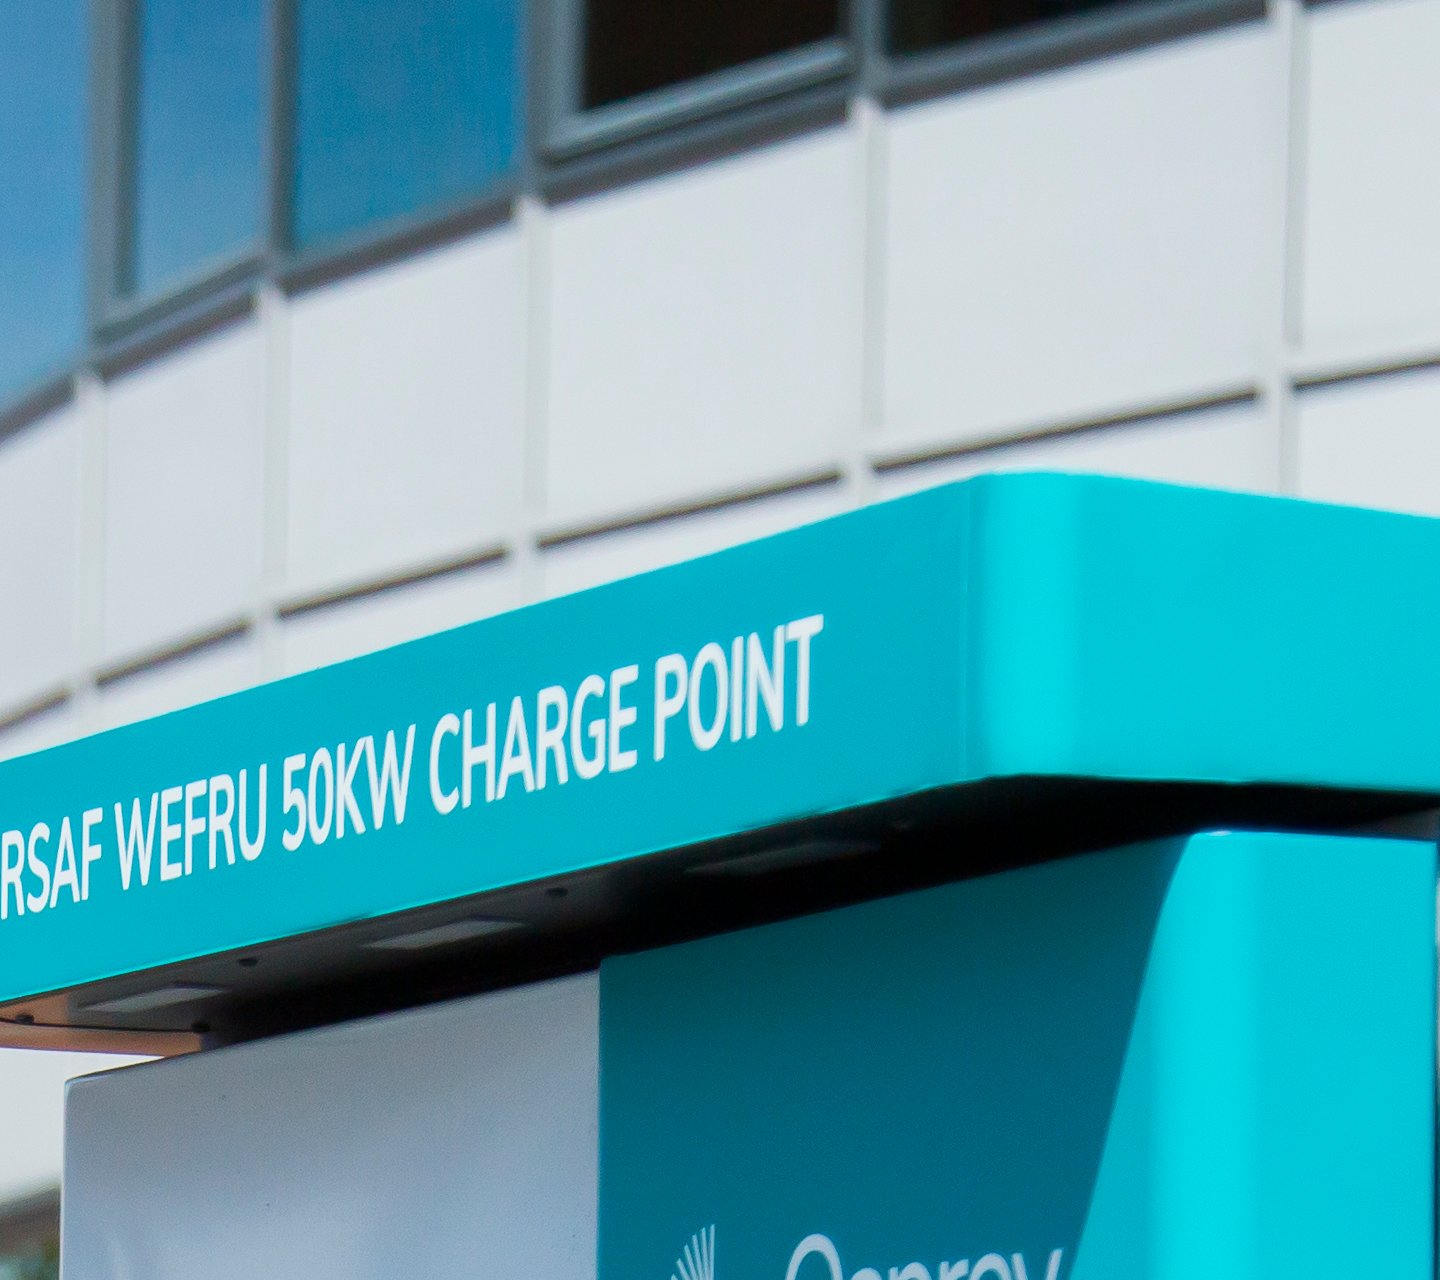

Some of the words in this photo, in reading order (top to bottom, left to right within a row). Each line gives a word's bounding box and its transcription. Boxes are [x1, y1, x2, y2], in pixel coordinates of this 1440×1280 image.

[114, 762, 270, 890] WEFRU
[282, 722, 417, 852] 50KW
[428, 664, 639, 816] CHARGE
[653, 613, 825, 761] POINT
